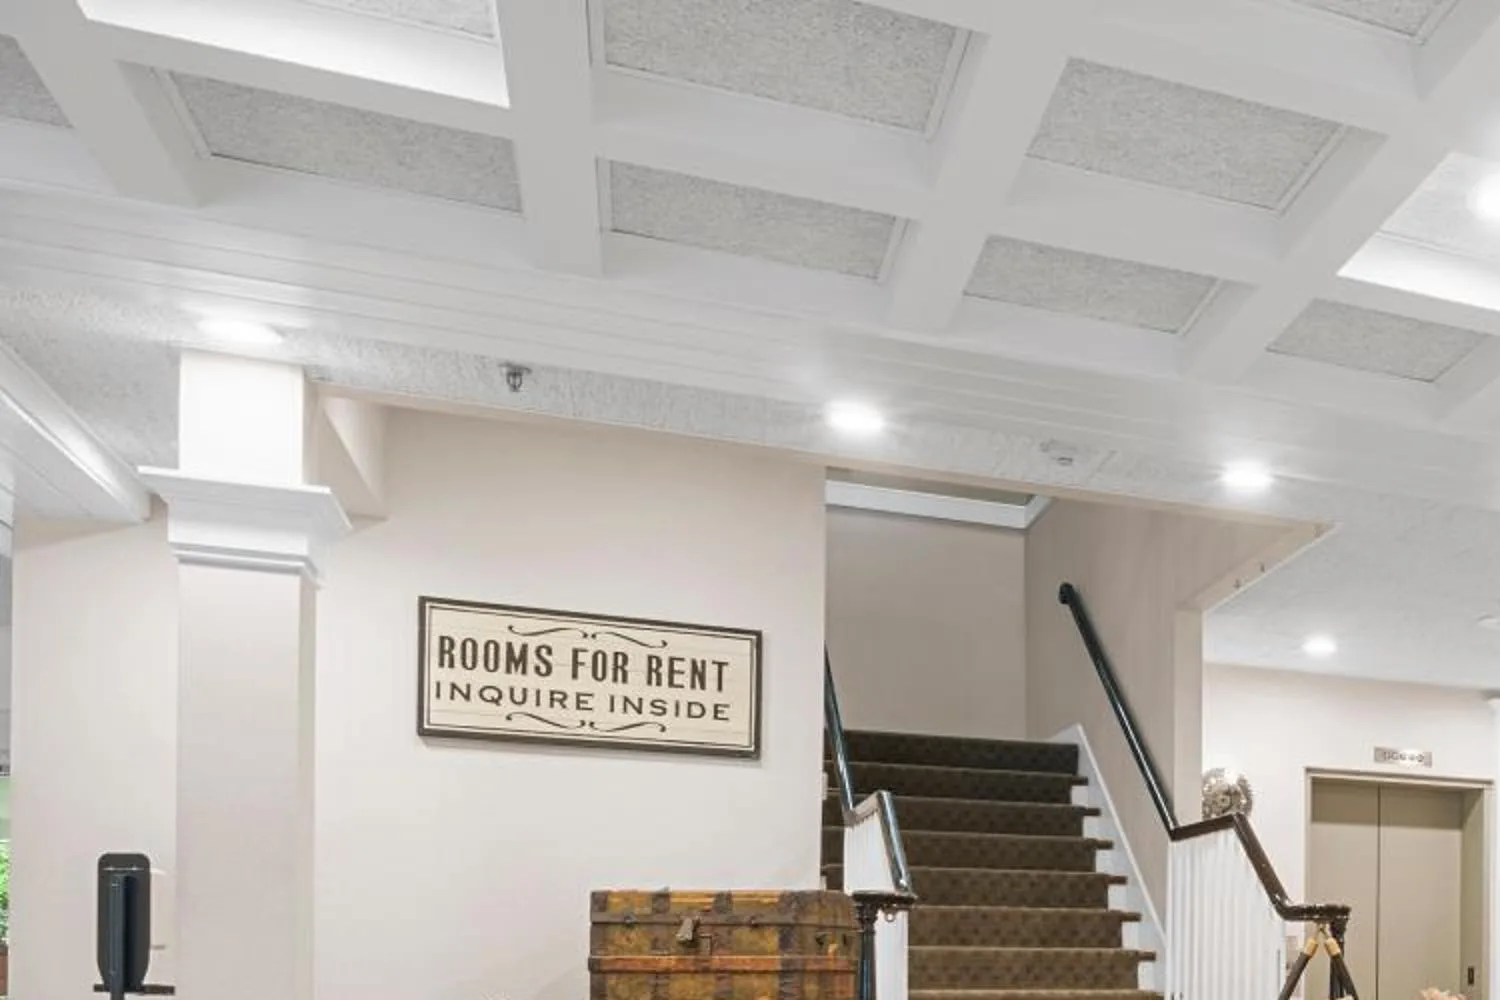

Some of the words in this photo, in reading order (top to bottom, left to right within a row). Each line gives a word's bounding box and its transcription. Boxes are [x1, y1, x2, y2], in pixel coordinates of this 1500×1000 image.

[438, 635, 553, 678] ROOMS
[571, 647, 629, 685] FOR
[646, 654, 730, 693] RENT
[435, 681, 595, 712] INQUIRE
[609, 694, 731, 722] INSIDE
